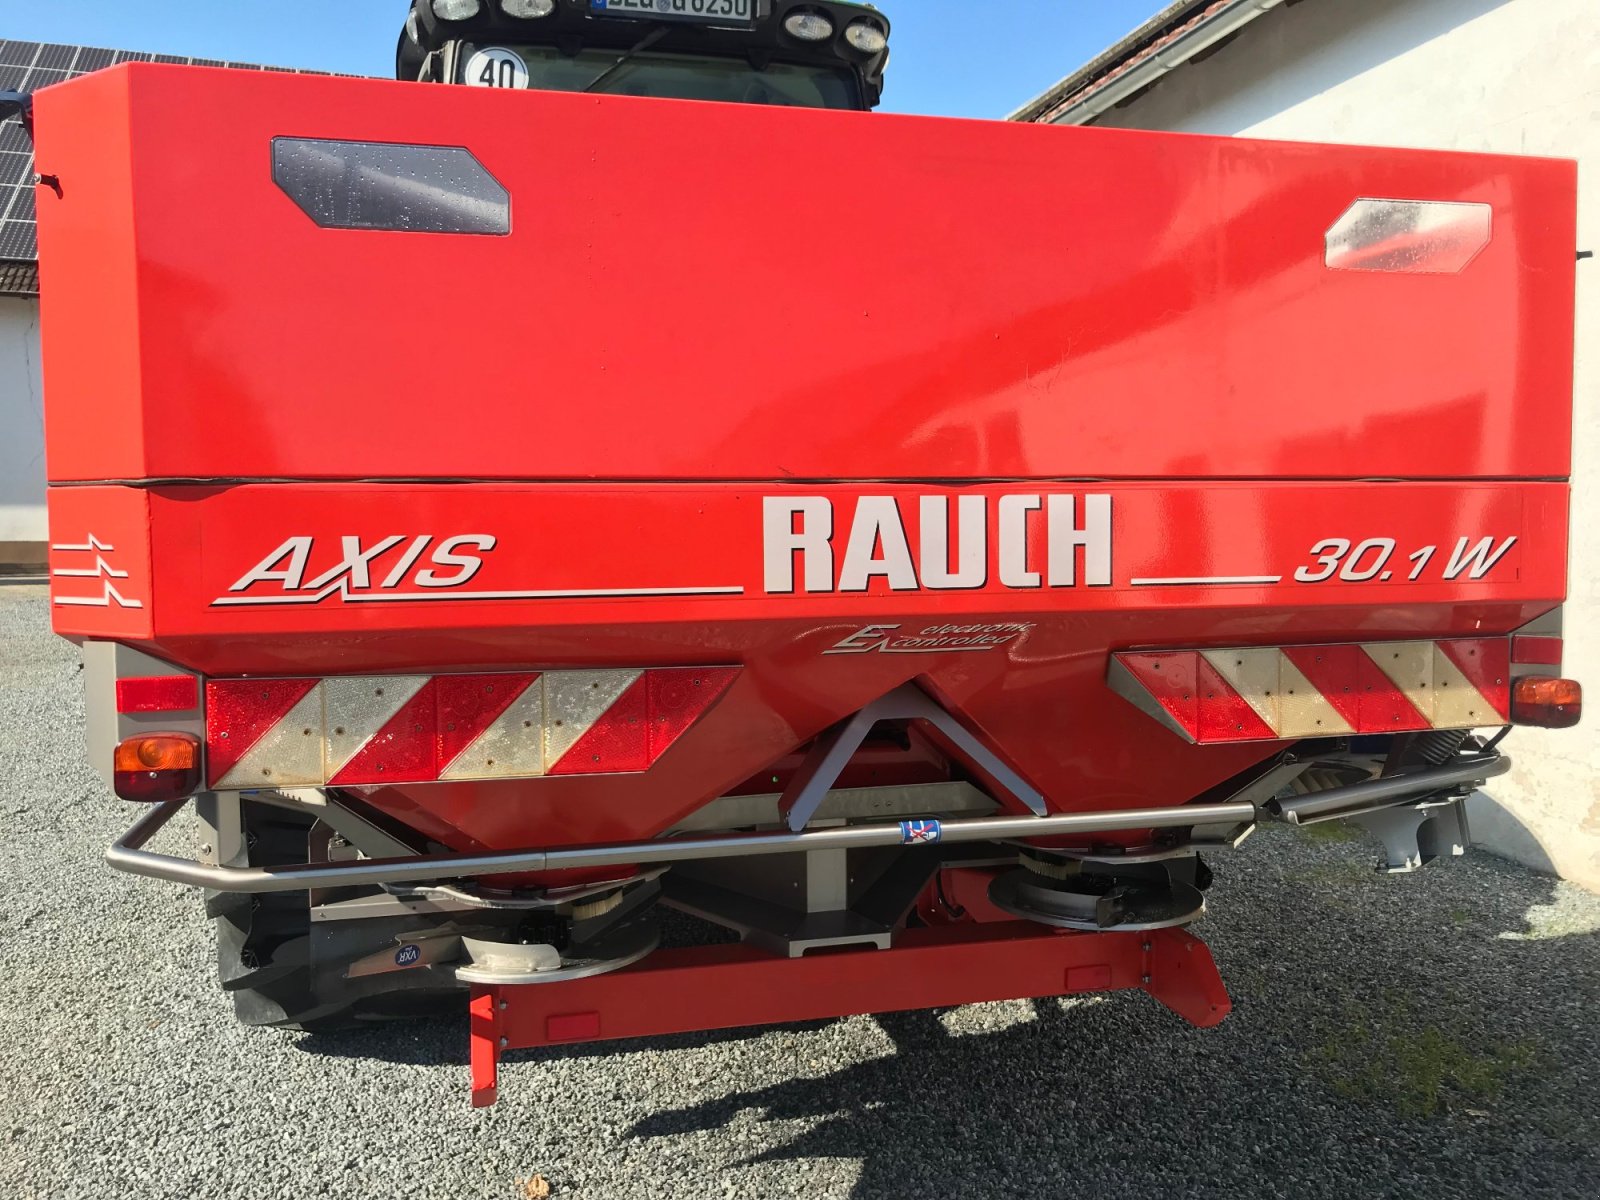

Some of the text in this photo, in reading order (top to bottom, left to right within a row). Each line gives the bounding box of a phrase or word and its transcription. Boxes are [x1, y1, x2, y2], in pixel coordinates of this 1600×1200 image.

[479, 58, 516, 88] 40
[229, 534, 498, 591] AXIS
[763, 494, 1113, 593] RAUCH
[1441, 535, 1518, 581] W
[891, 634, 1019, 648] controlled
[919, 622, 1037, 636] electronic
